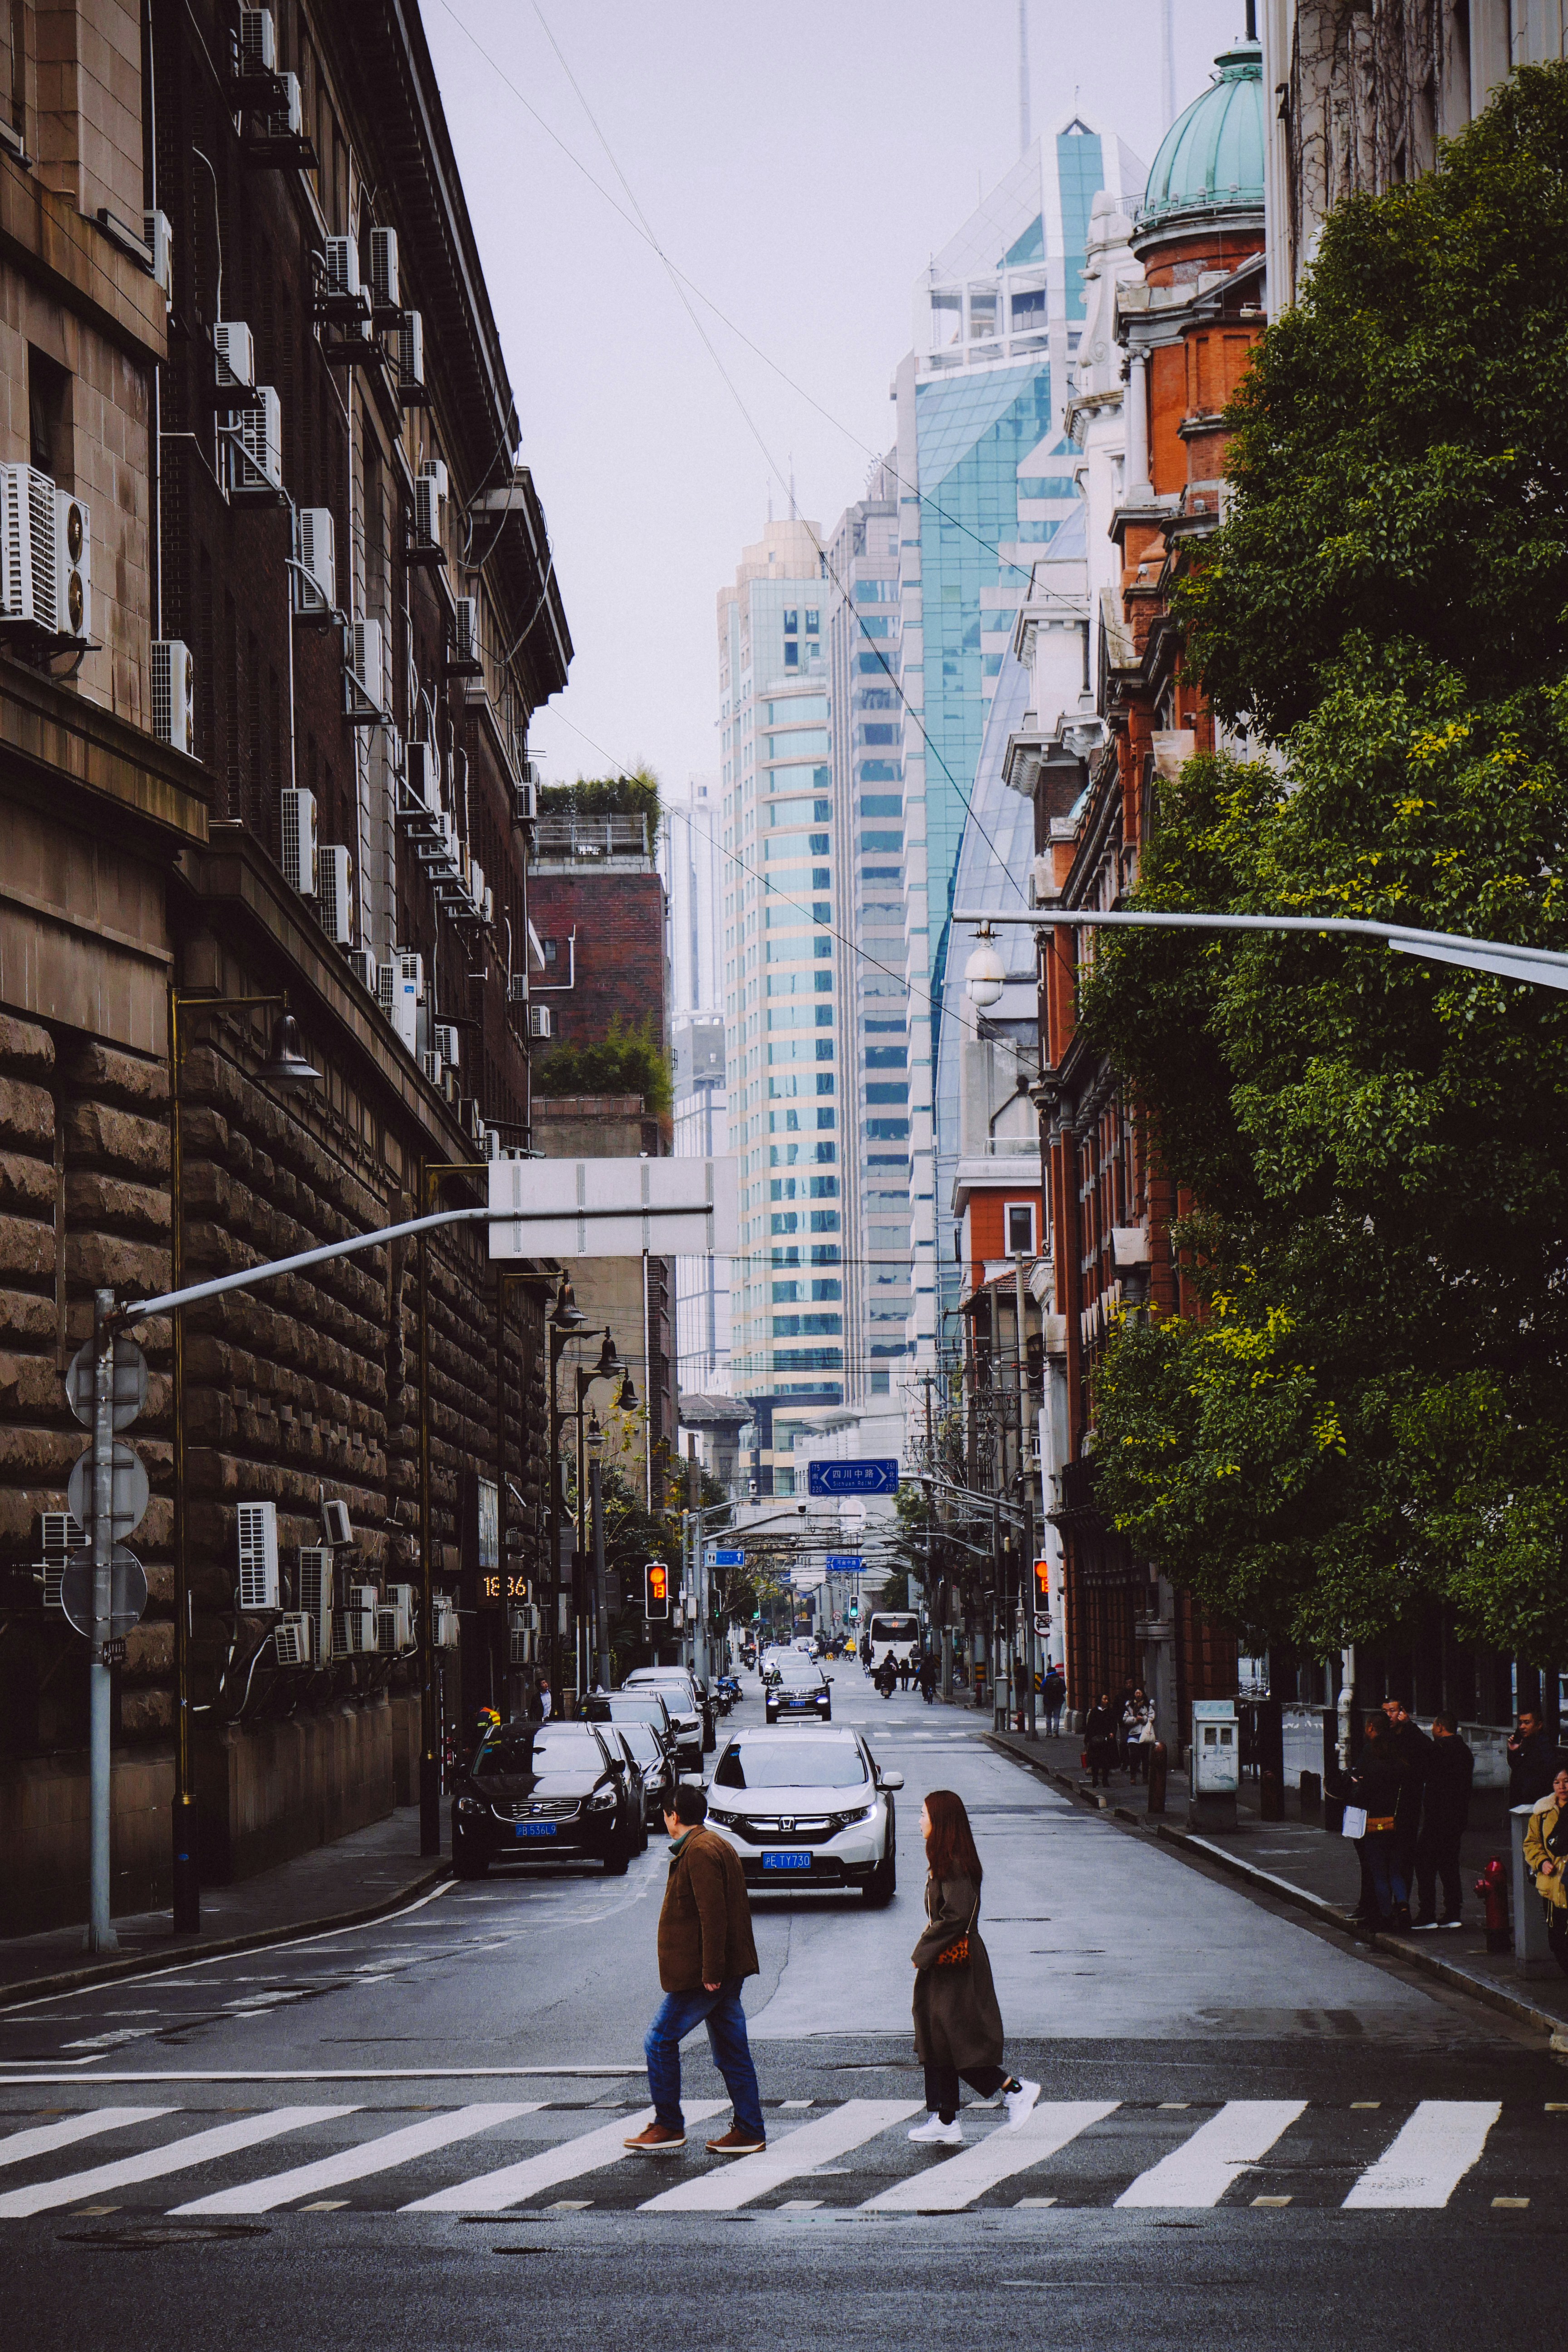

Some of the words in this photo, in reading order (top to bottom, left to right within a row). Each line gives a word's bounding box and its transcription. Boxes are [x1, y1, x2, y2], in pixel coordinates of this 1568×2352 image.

[833, 1470, 873, 1479] 四川中路
[654, 1584, 664, 1598] 13
